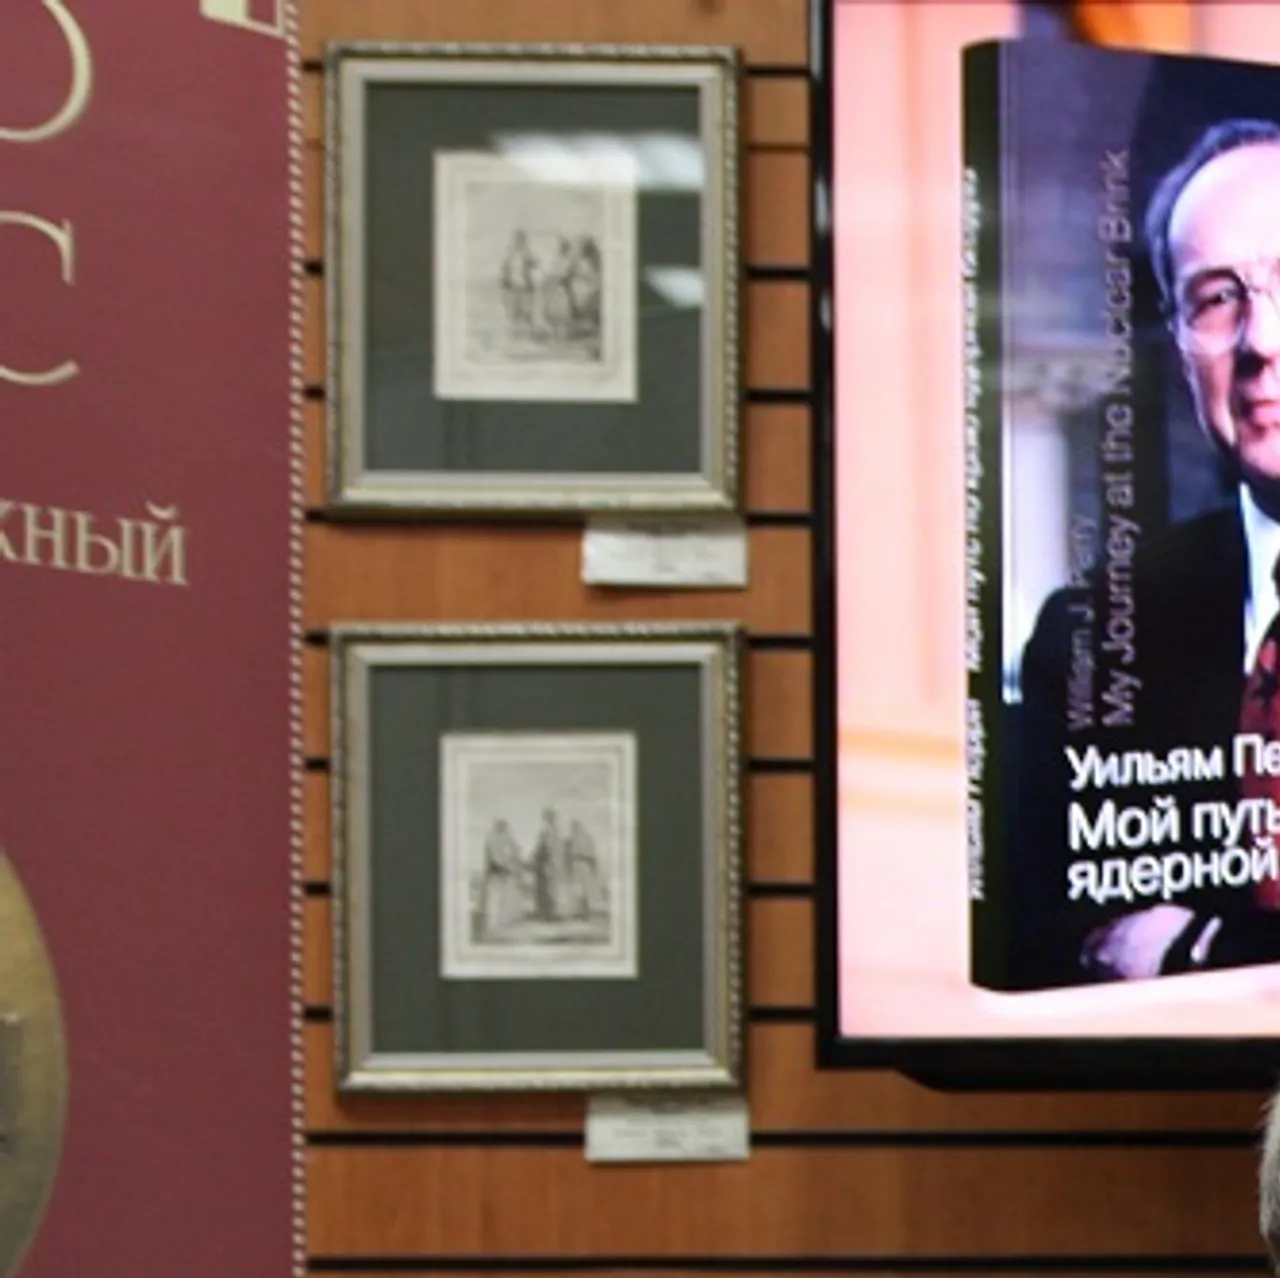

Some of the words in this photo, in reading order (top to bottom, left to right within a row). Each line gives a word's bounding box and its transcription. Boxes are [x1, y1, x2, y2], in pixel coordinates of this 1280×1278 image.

[1101, 403, 1135, 463] the
[1102, 472, 1135, 509] at
[1101, 514, 1142, 666] Journey
[1101, 668, 1143, 728] My
[1065, 745, 1224, 792] Уильям
[1067, 796, 1179, 853] Мой
[1067, 840, 1279, 904] ядерной
